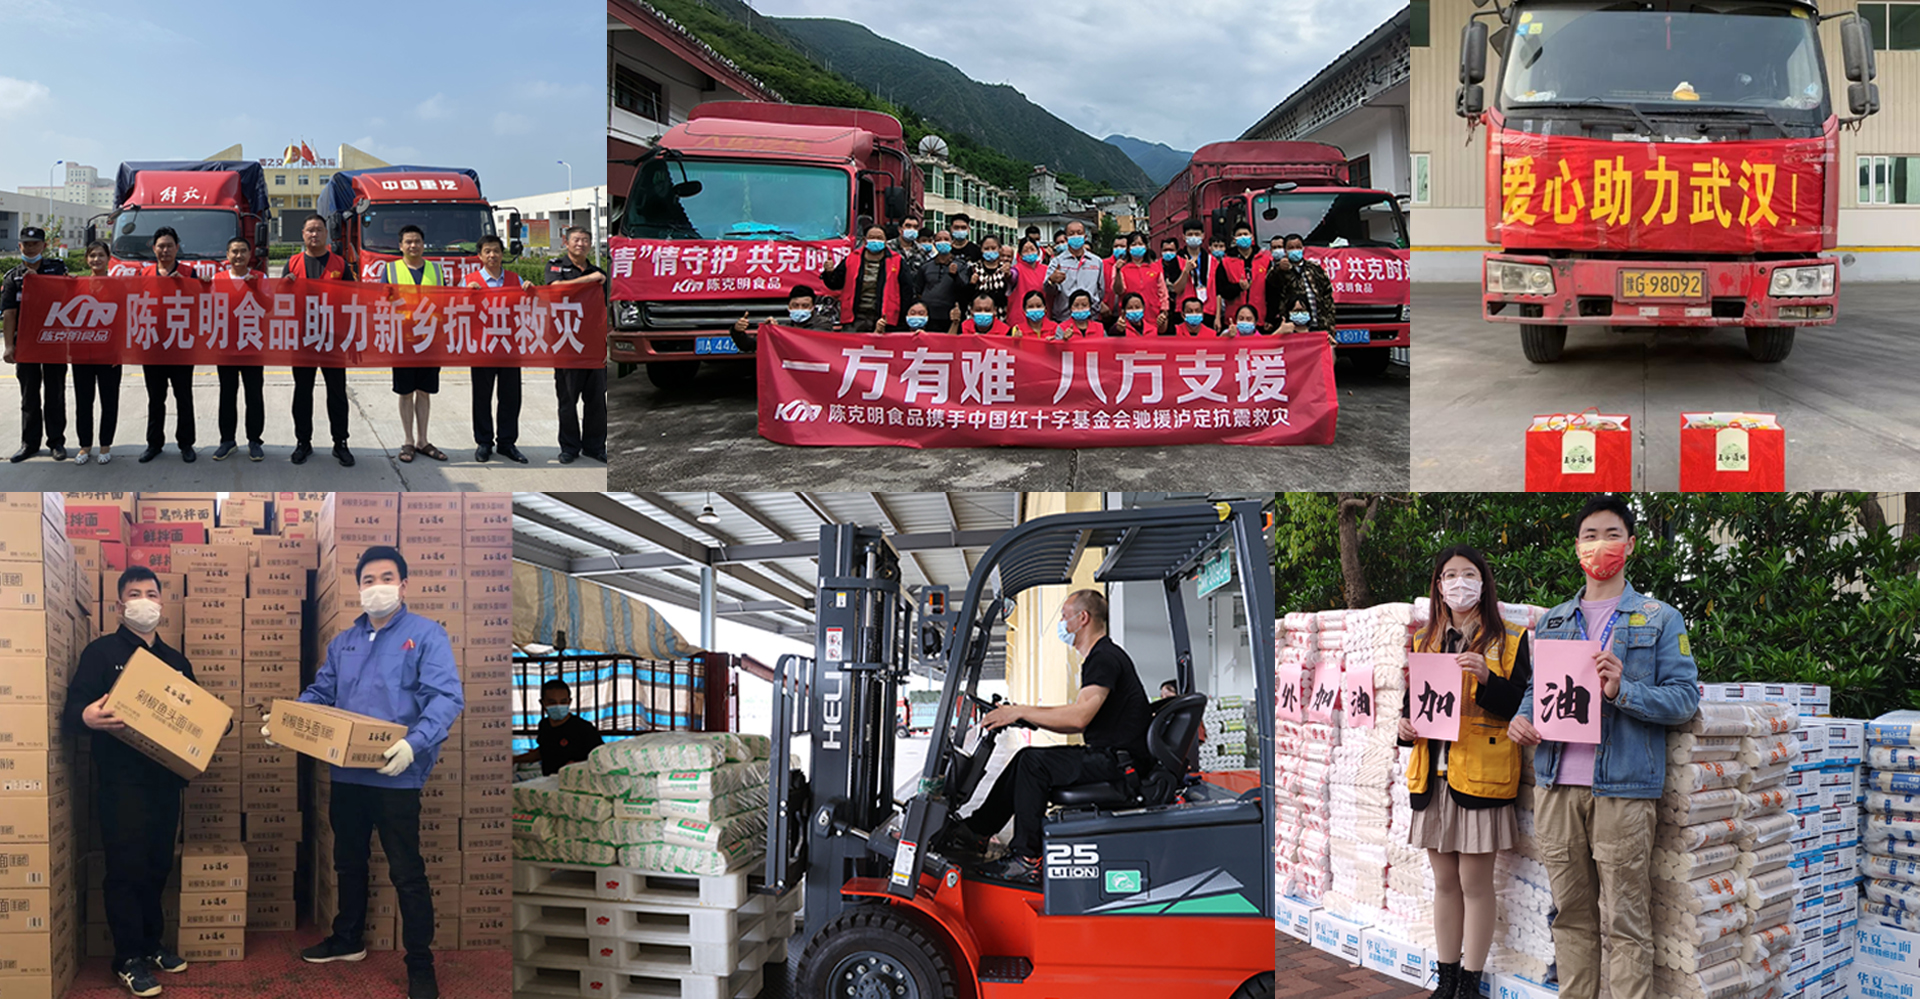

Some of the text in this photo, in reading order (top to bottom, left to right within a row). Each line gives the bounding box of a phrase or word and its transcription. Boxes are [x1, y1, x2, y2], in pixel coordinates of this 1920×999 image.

[382, 179, 459, 191] 中国重汽
[707, 278, 782, 292] 陈克明食品
[1332, 282, 1375, 294] 克明食品
[126, 290, 585, 354] 陈克明食品助力新乡抗洪救灾
[39, 330, 110, 342] 陈克明食品
[782, 345, 1289, 405] 一方有难 八方支援
[828, 404, 1291, 429] 陈克明食品携手中国红十字基金会驰援泸定抗震救灾
[159, 508, 210, 521] 黑鸭拌面
[143, 528, 184, 542] 鲜拌面
[135, 689, 188, 729] 剁椒鱼头面
[1282, 683, 1298, 712] 外
[1312, 683, 1334, 711] 加
[1350, 686, 1371, 717] 油
[1414, 681, 1456, 722] 加
[1541, 674, 1591, 725] 油
[822, 671, 843, 749] HELI
[281, 712, 321, 737] 剁椒鱼头面
[1046, 844, 1099, 865] 25
[1857, 930, 1911, 954] 华夏一面
[1857, 972, 1913, 997] 华夏一面
